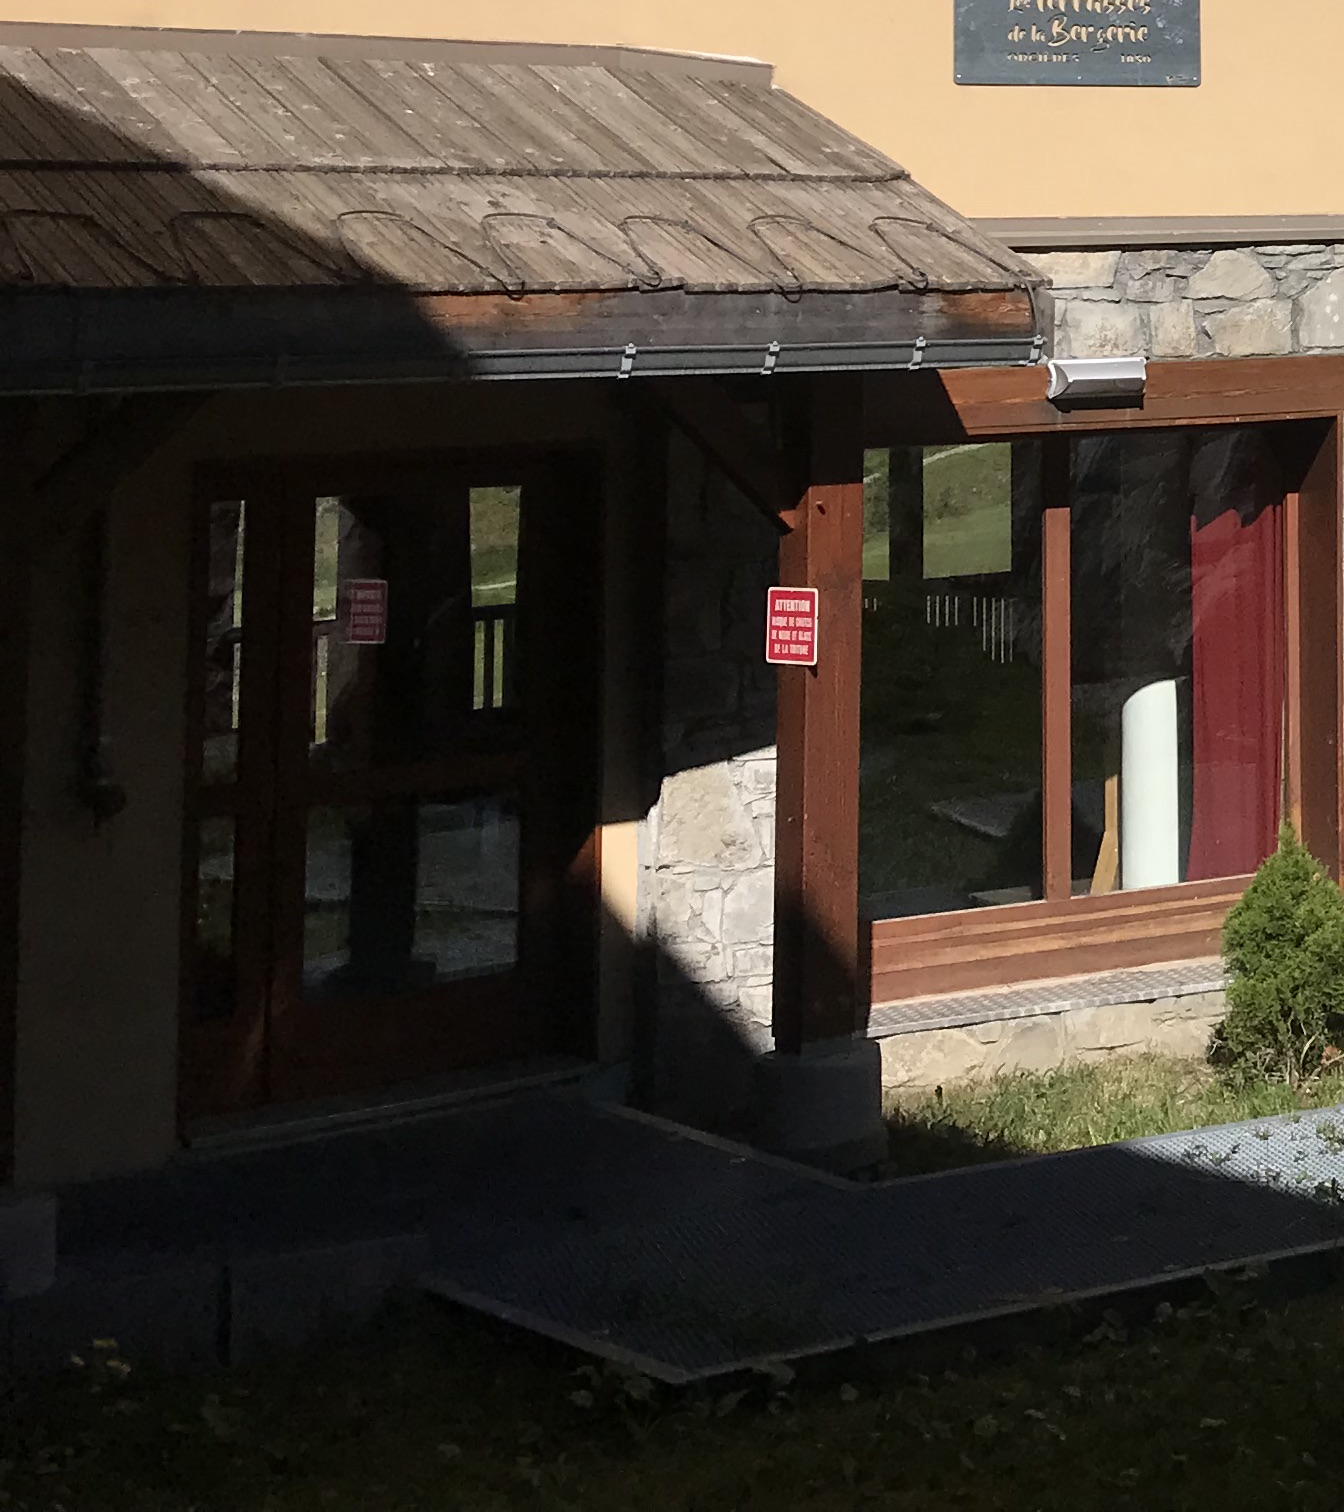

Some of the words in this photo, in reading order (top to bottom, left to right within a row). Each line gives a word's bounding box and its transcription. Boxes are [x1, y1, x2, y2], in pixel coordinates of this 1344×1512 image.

[1007, 23, 1026, 42] de
[1031, 23, 1046, 42] la
[1047, 13, 1149, 53] Bergerie
[775, 599, 810, 612] ATTENTION
[774, 643, 780, 654] DE
[782, 644, 789, 654] LA
